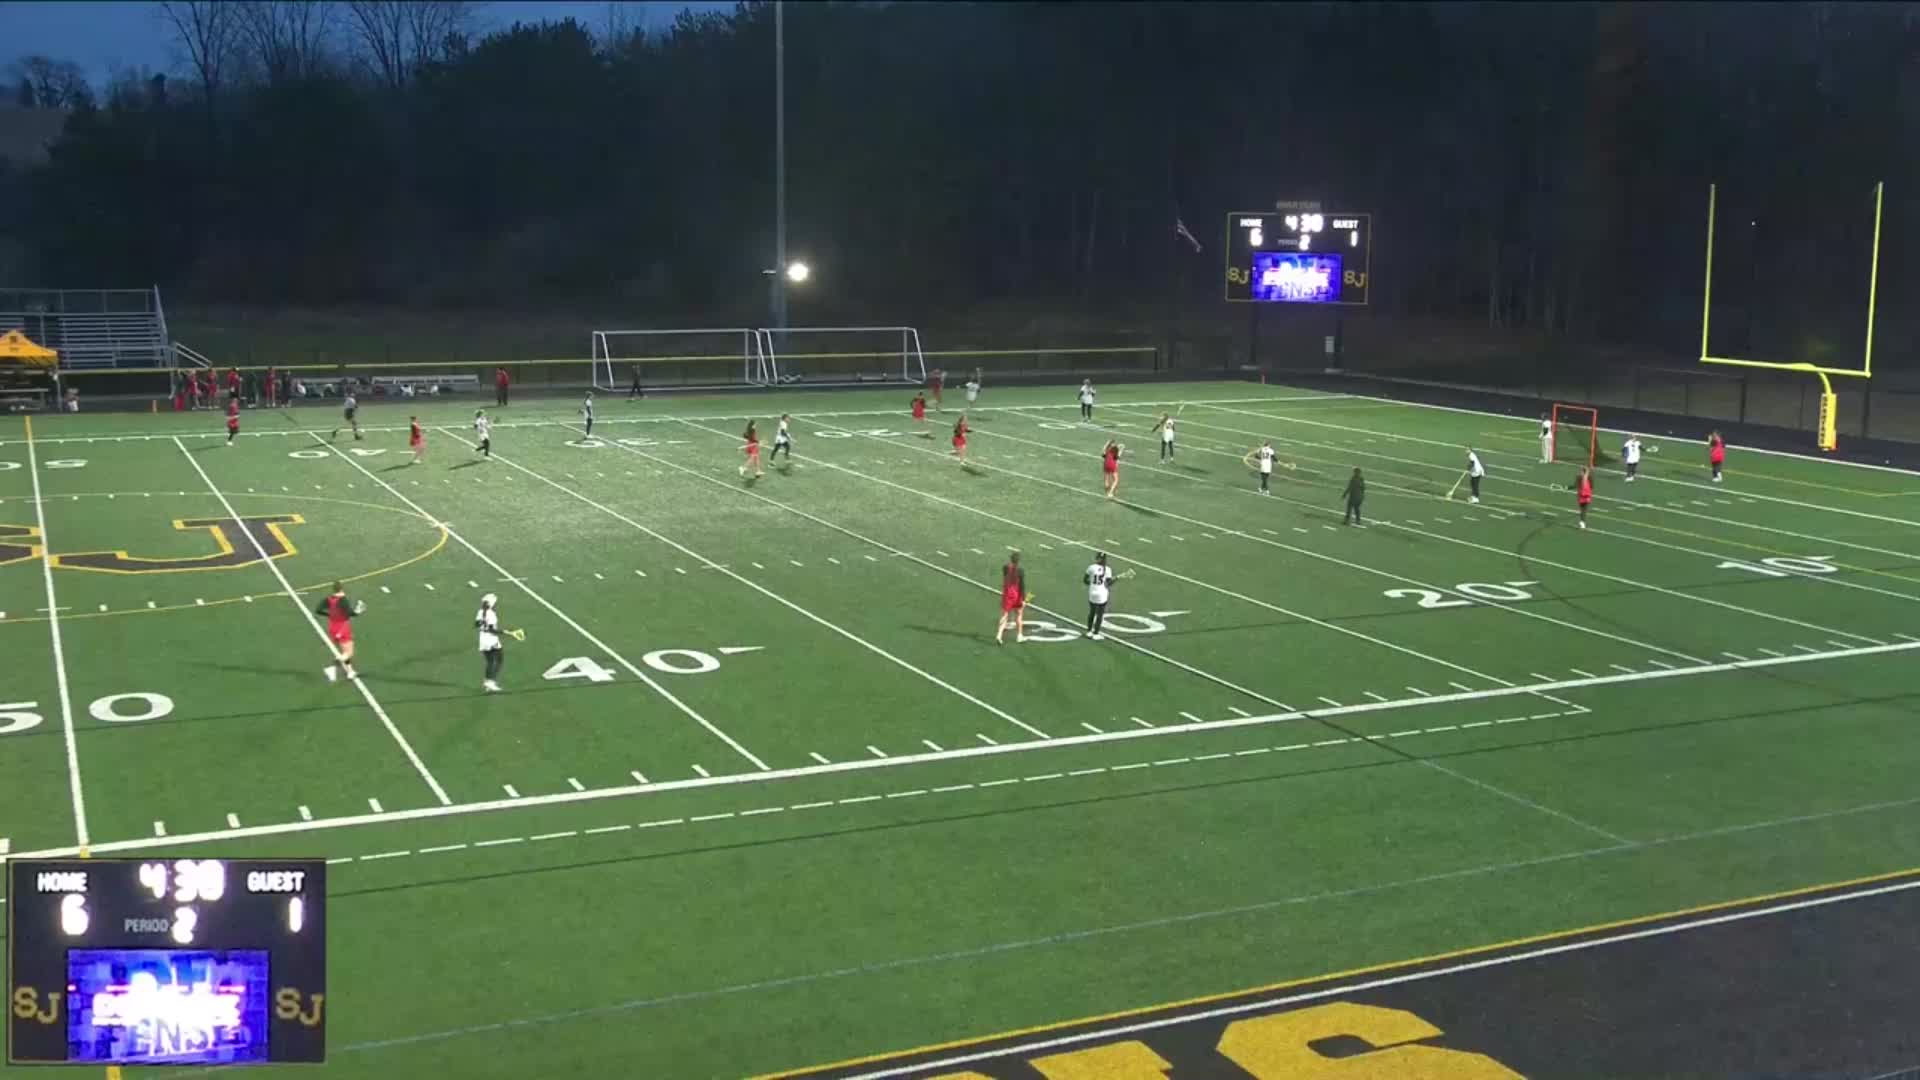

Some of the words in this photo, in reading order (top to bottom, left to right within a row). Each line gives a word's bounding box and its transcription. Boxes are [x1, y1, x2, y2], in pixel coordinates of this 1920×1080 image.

[1240, 219, 1263, 227] HOME
[1333, 220, 1359, 229] GUEST
[1250, 228, 1263, 246] 6
[1350, 231, 1358, 247] 1
[1093, 574, 1104, 585] 15
[1383, 581, 1534, 610] 20
[1005, 612, 1166, 642] 30
[542, 648, 720, 683] 40
